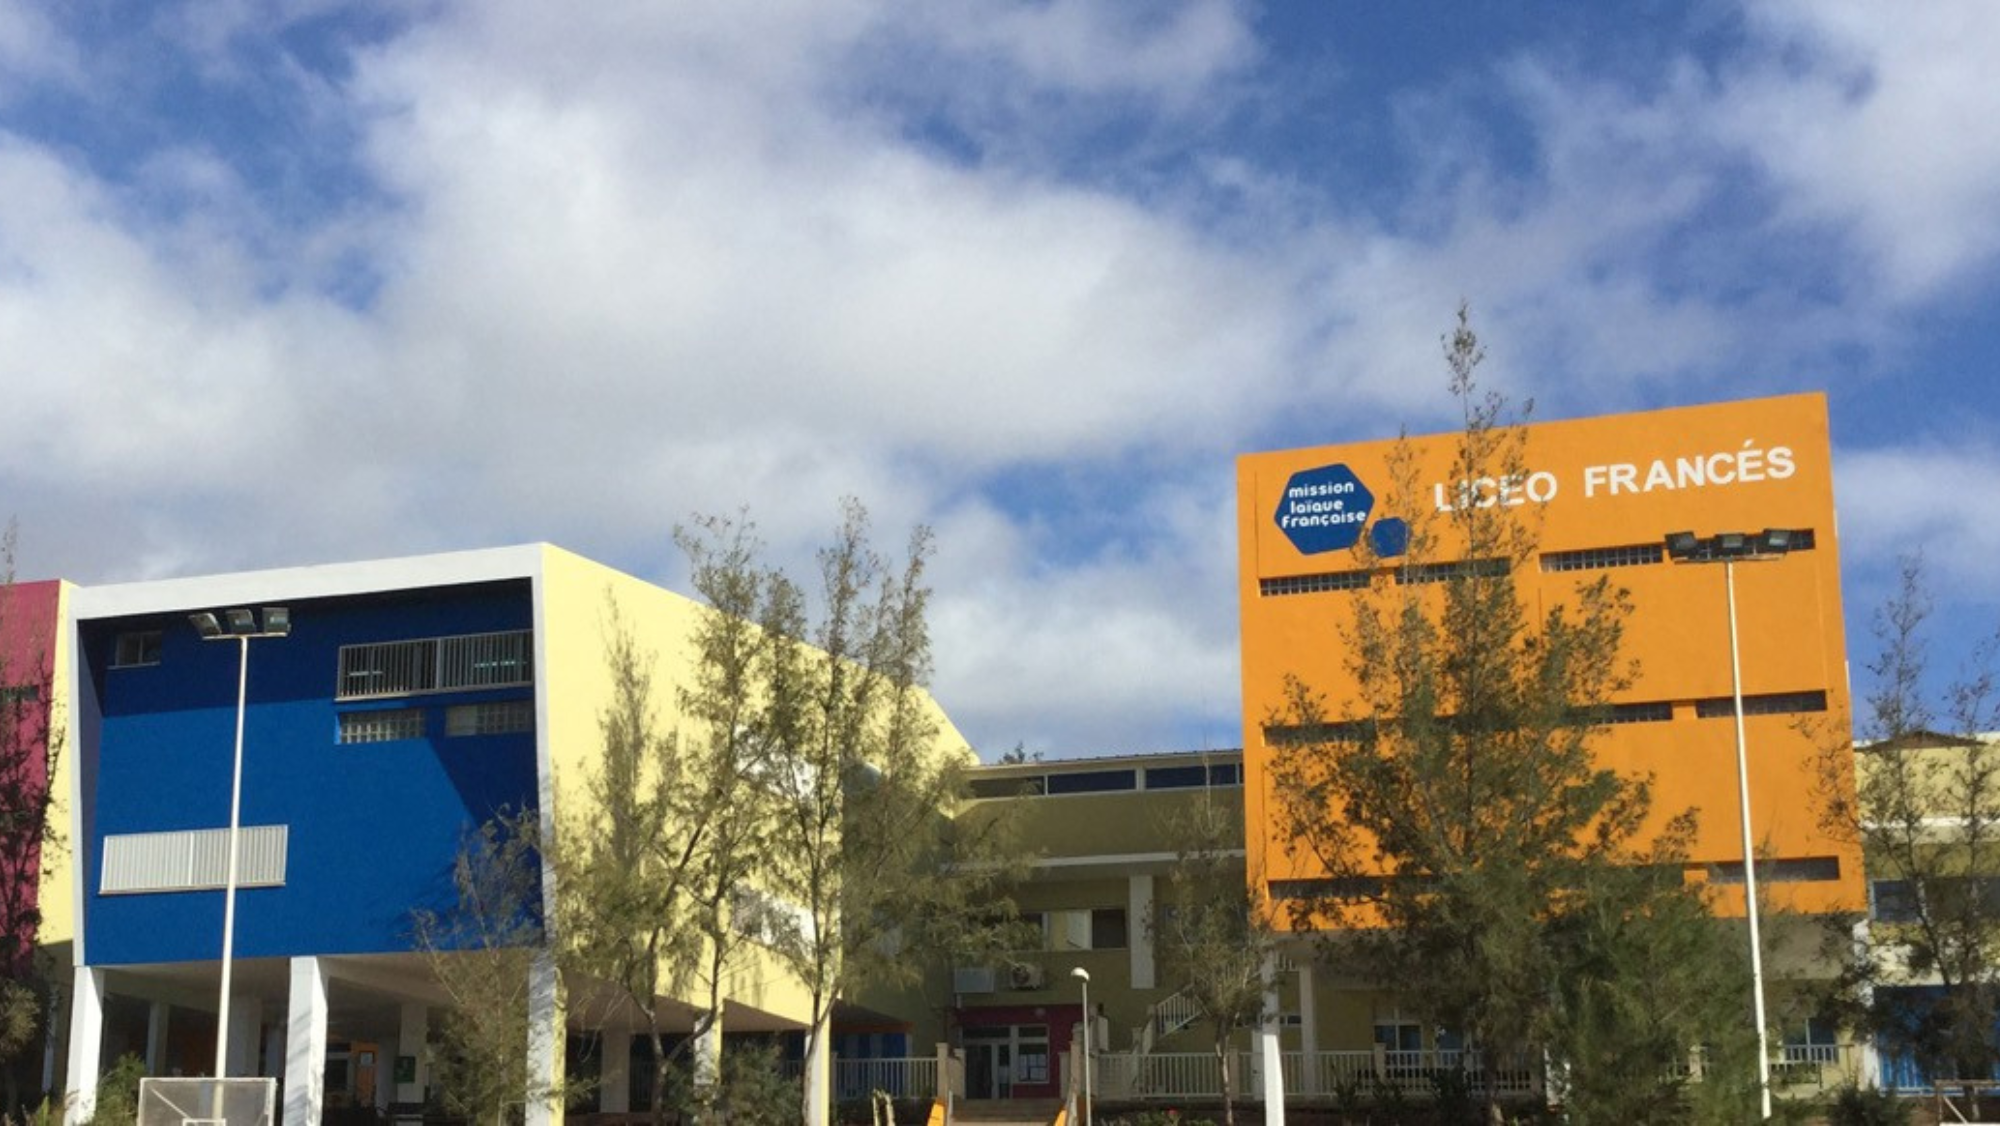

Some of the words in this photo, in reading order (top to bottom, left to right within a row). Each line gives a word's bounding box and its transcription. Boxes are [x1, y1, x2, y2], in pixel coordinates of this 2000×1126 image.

[1289, 481, 1354, 498] mission
[1434, 471, 1558, 512] LICEO
[1584, 438, 1796, 498] FRANCÉS
